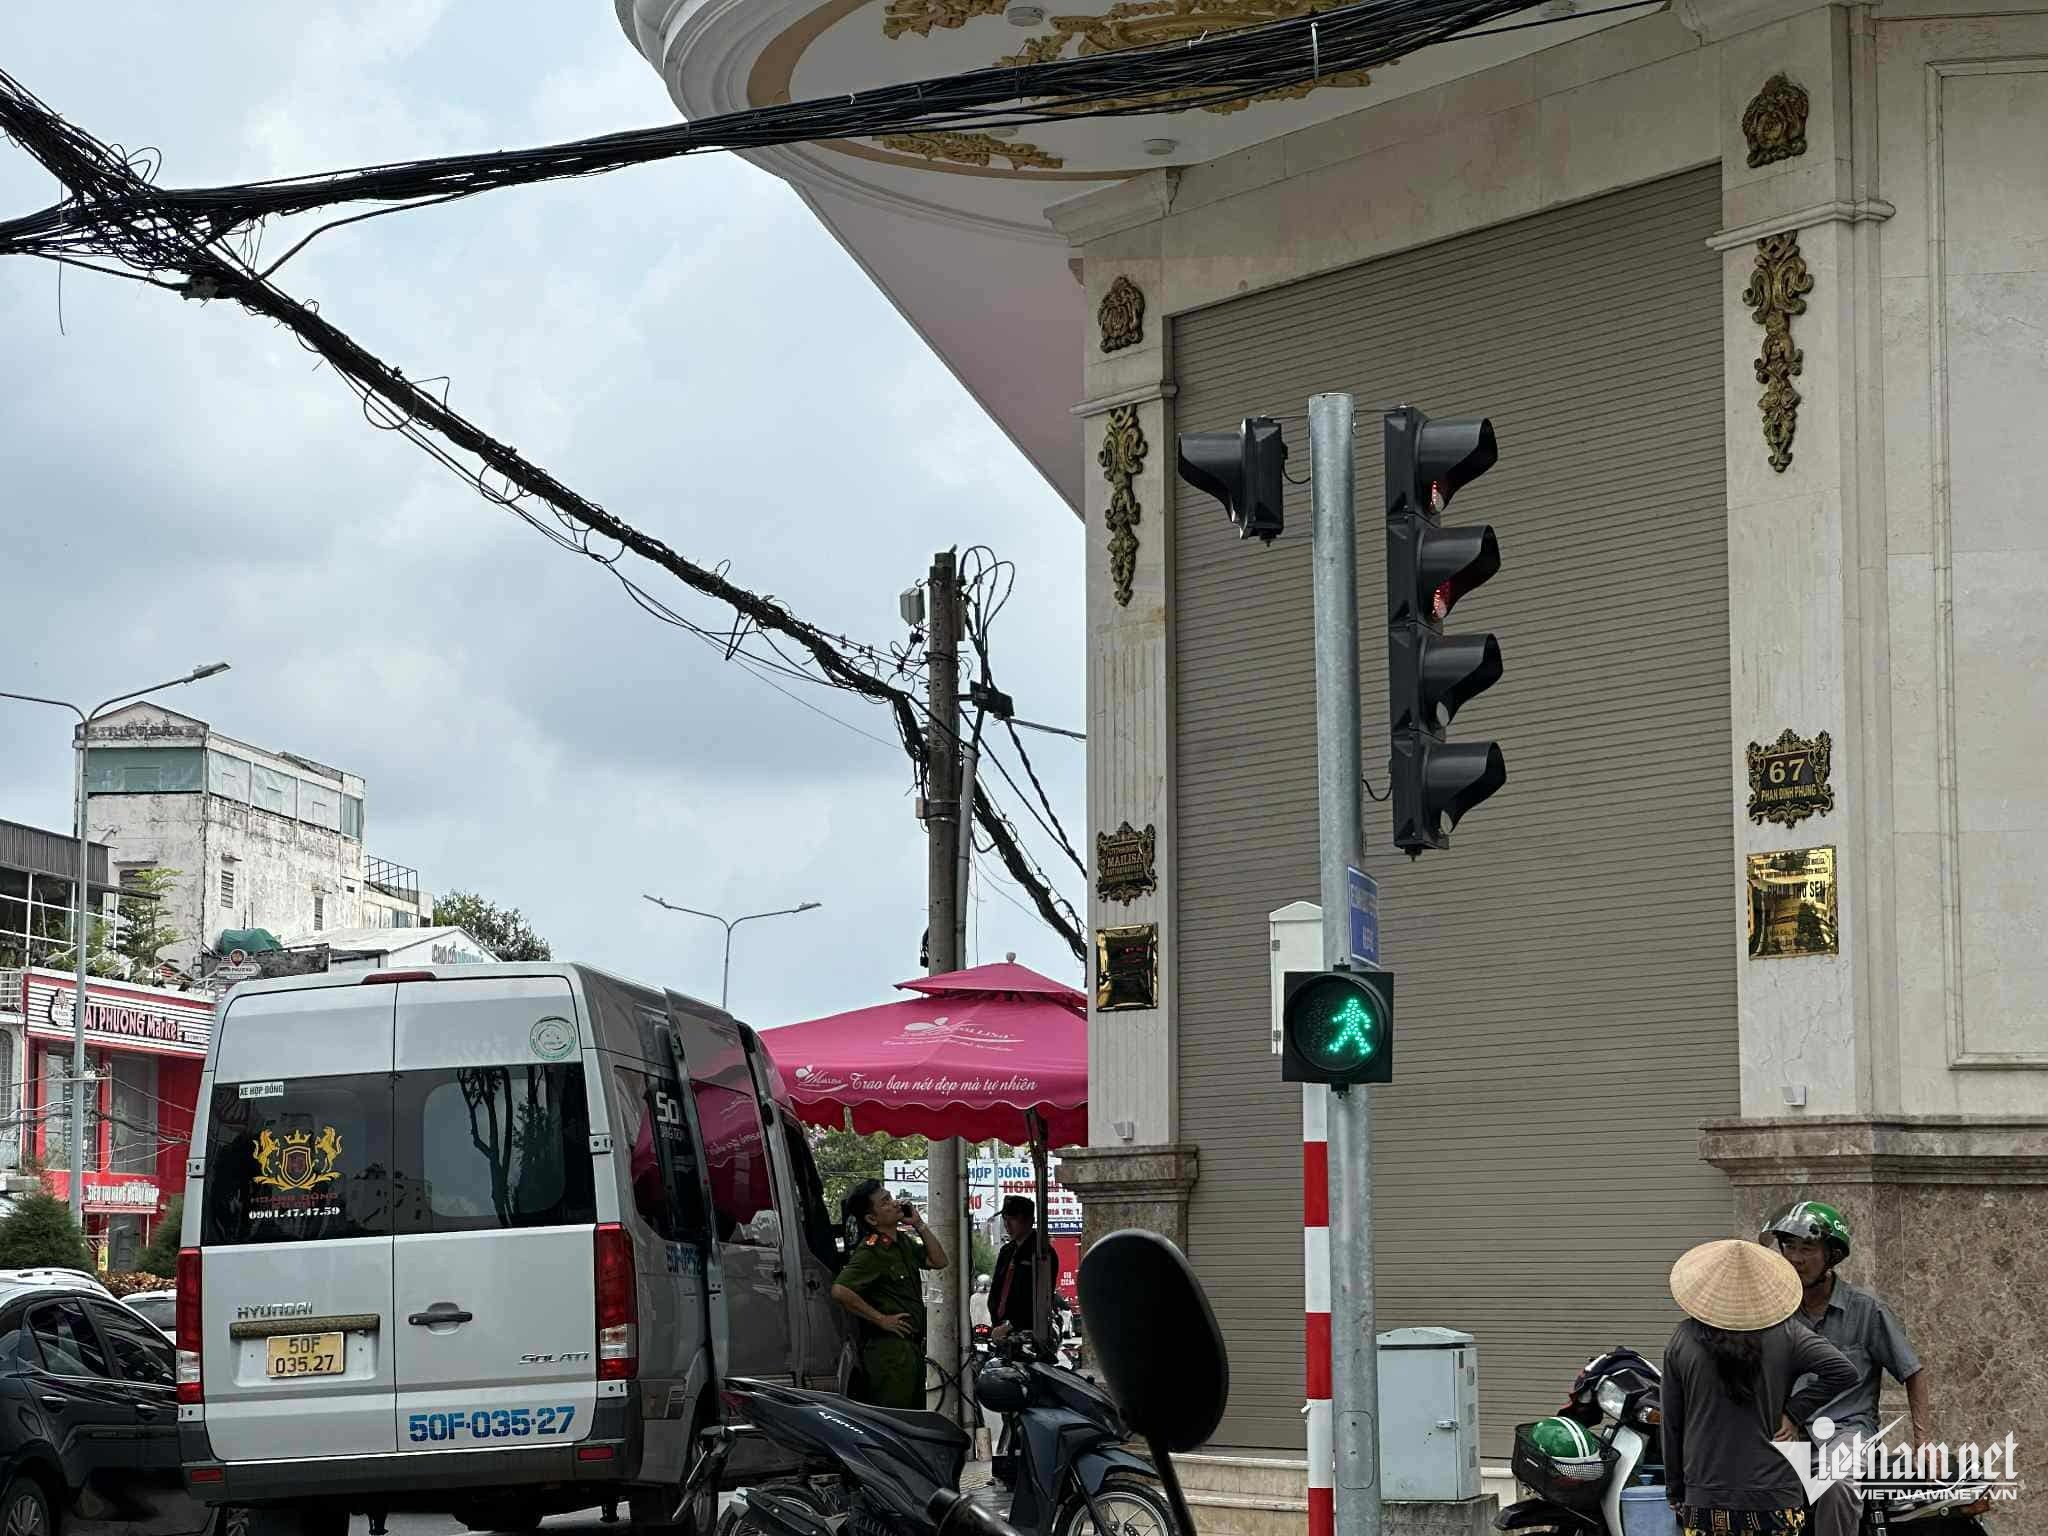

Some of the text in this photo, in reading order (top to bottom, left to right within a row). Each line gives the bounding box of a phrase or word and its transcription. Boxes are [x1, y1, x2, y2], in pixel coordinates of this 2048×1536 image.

[1769, 758, 1805, 784] 67
[1761, 787, 1778, 802] PHAN
[1107, 853, 1143, 869] MAILISA
[1809, 880, 1826, 898] SEN
[239, 1087, 249, 1097] XE
[250, 1086, 263, 1097] HỢP
[886, 1074, 910, 1094] bạn
[934, 1075, 958, 1097] đẹp
[959, 1076, 981, 1091] mà
[983, 1078, 999, 1095] tự
[1000, 1074, 1037, 1091] nhiên
[248, 1206, 341, 1220] 0901.47.47.59
[236, 1301, 313, 1320] HYUNDAI
[288, 1336, 321, 1354] 50F
[275, 1354, 335, 1374] 035.27
[518, 1351, 590, 1366] SOLATI
